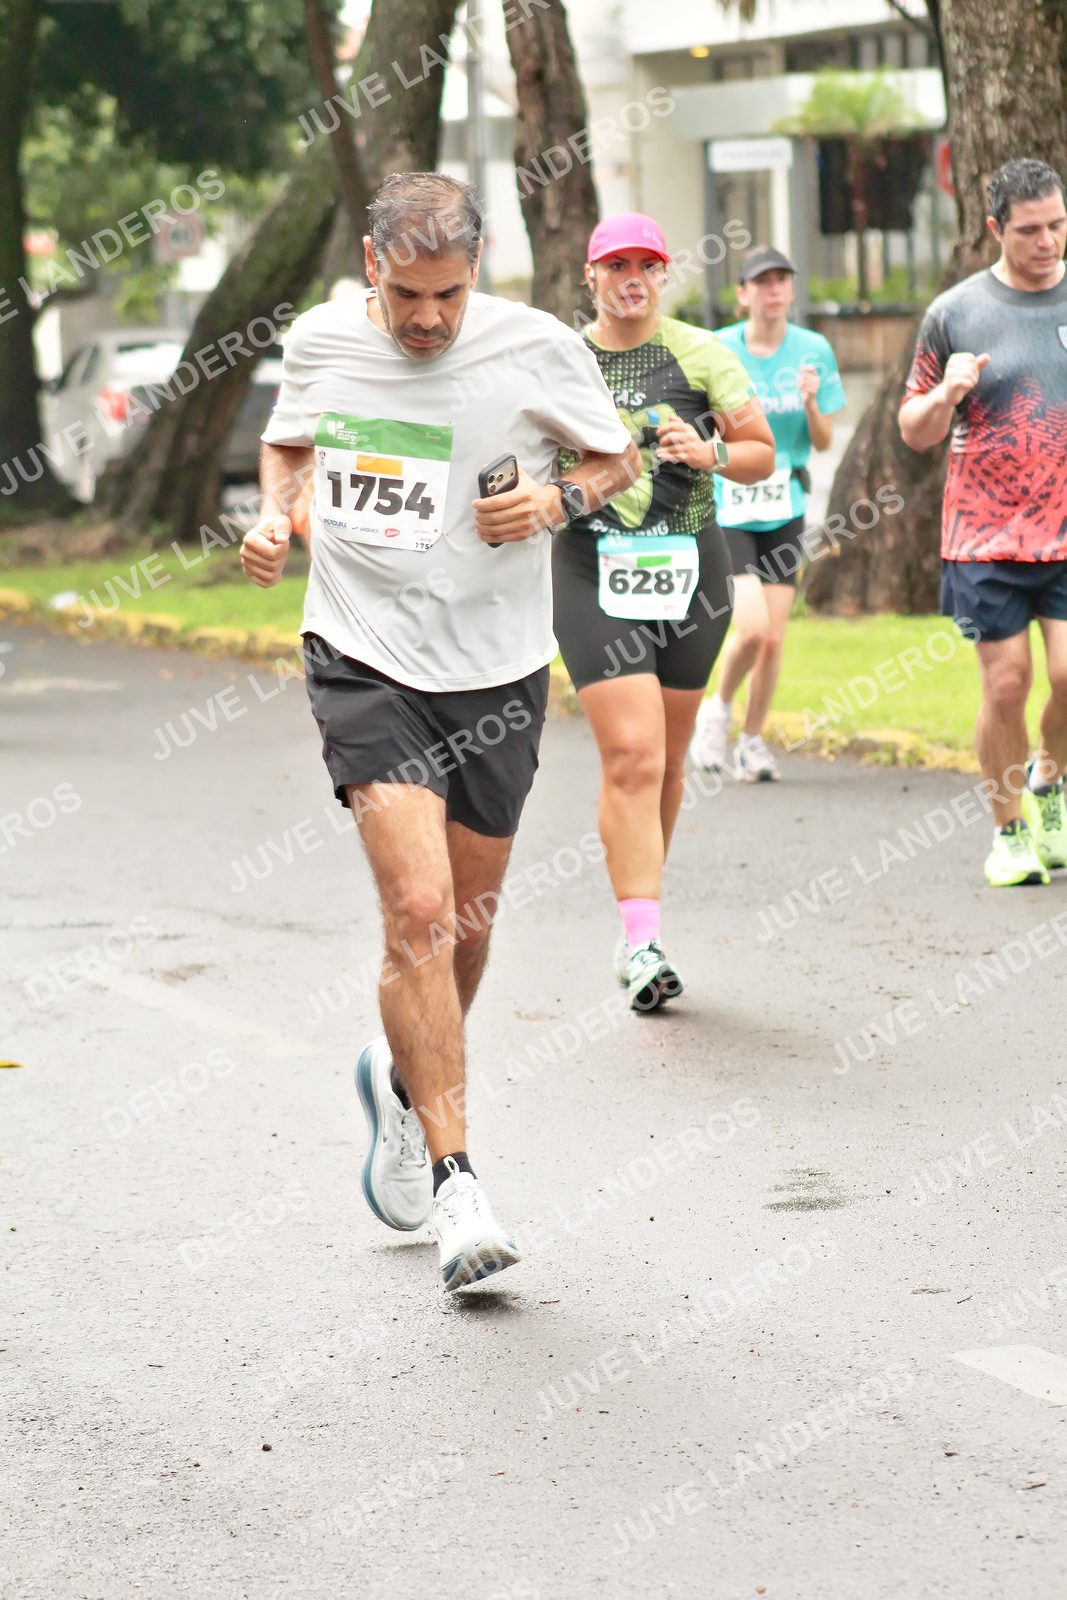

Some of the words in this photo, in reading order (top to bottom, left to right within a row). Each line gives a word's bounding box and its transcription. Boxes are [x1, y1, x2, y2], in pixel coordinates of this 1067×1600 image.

[327, 470, 435, 520] 1754
[731, 484, 786, 505] 5752
[608, 568, 693, 595] 6287
